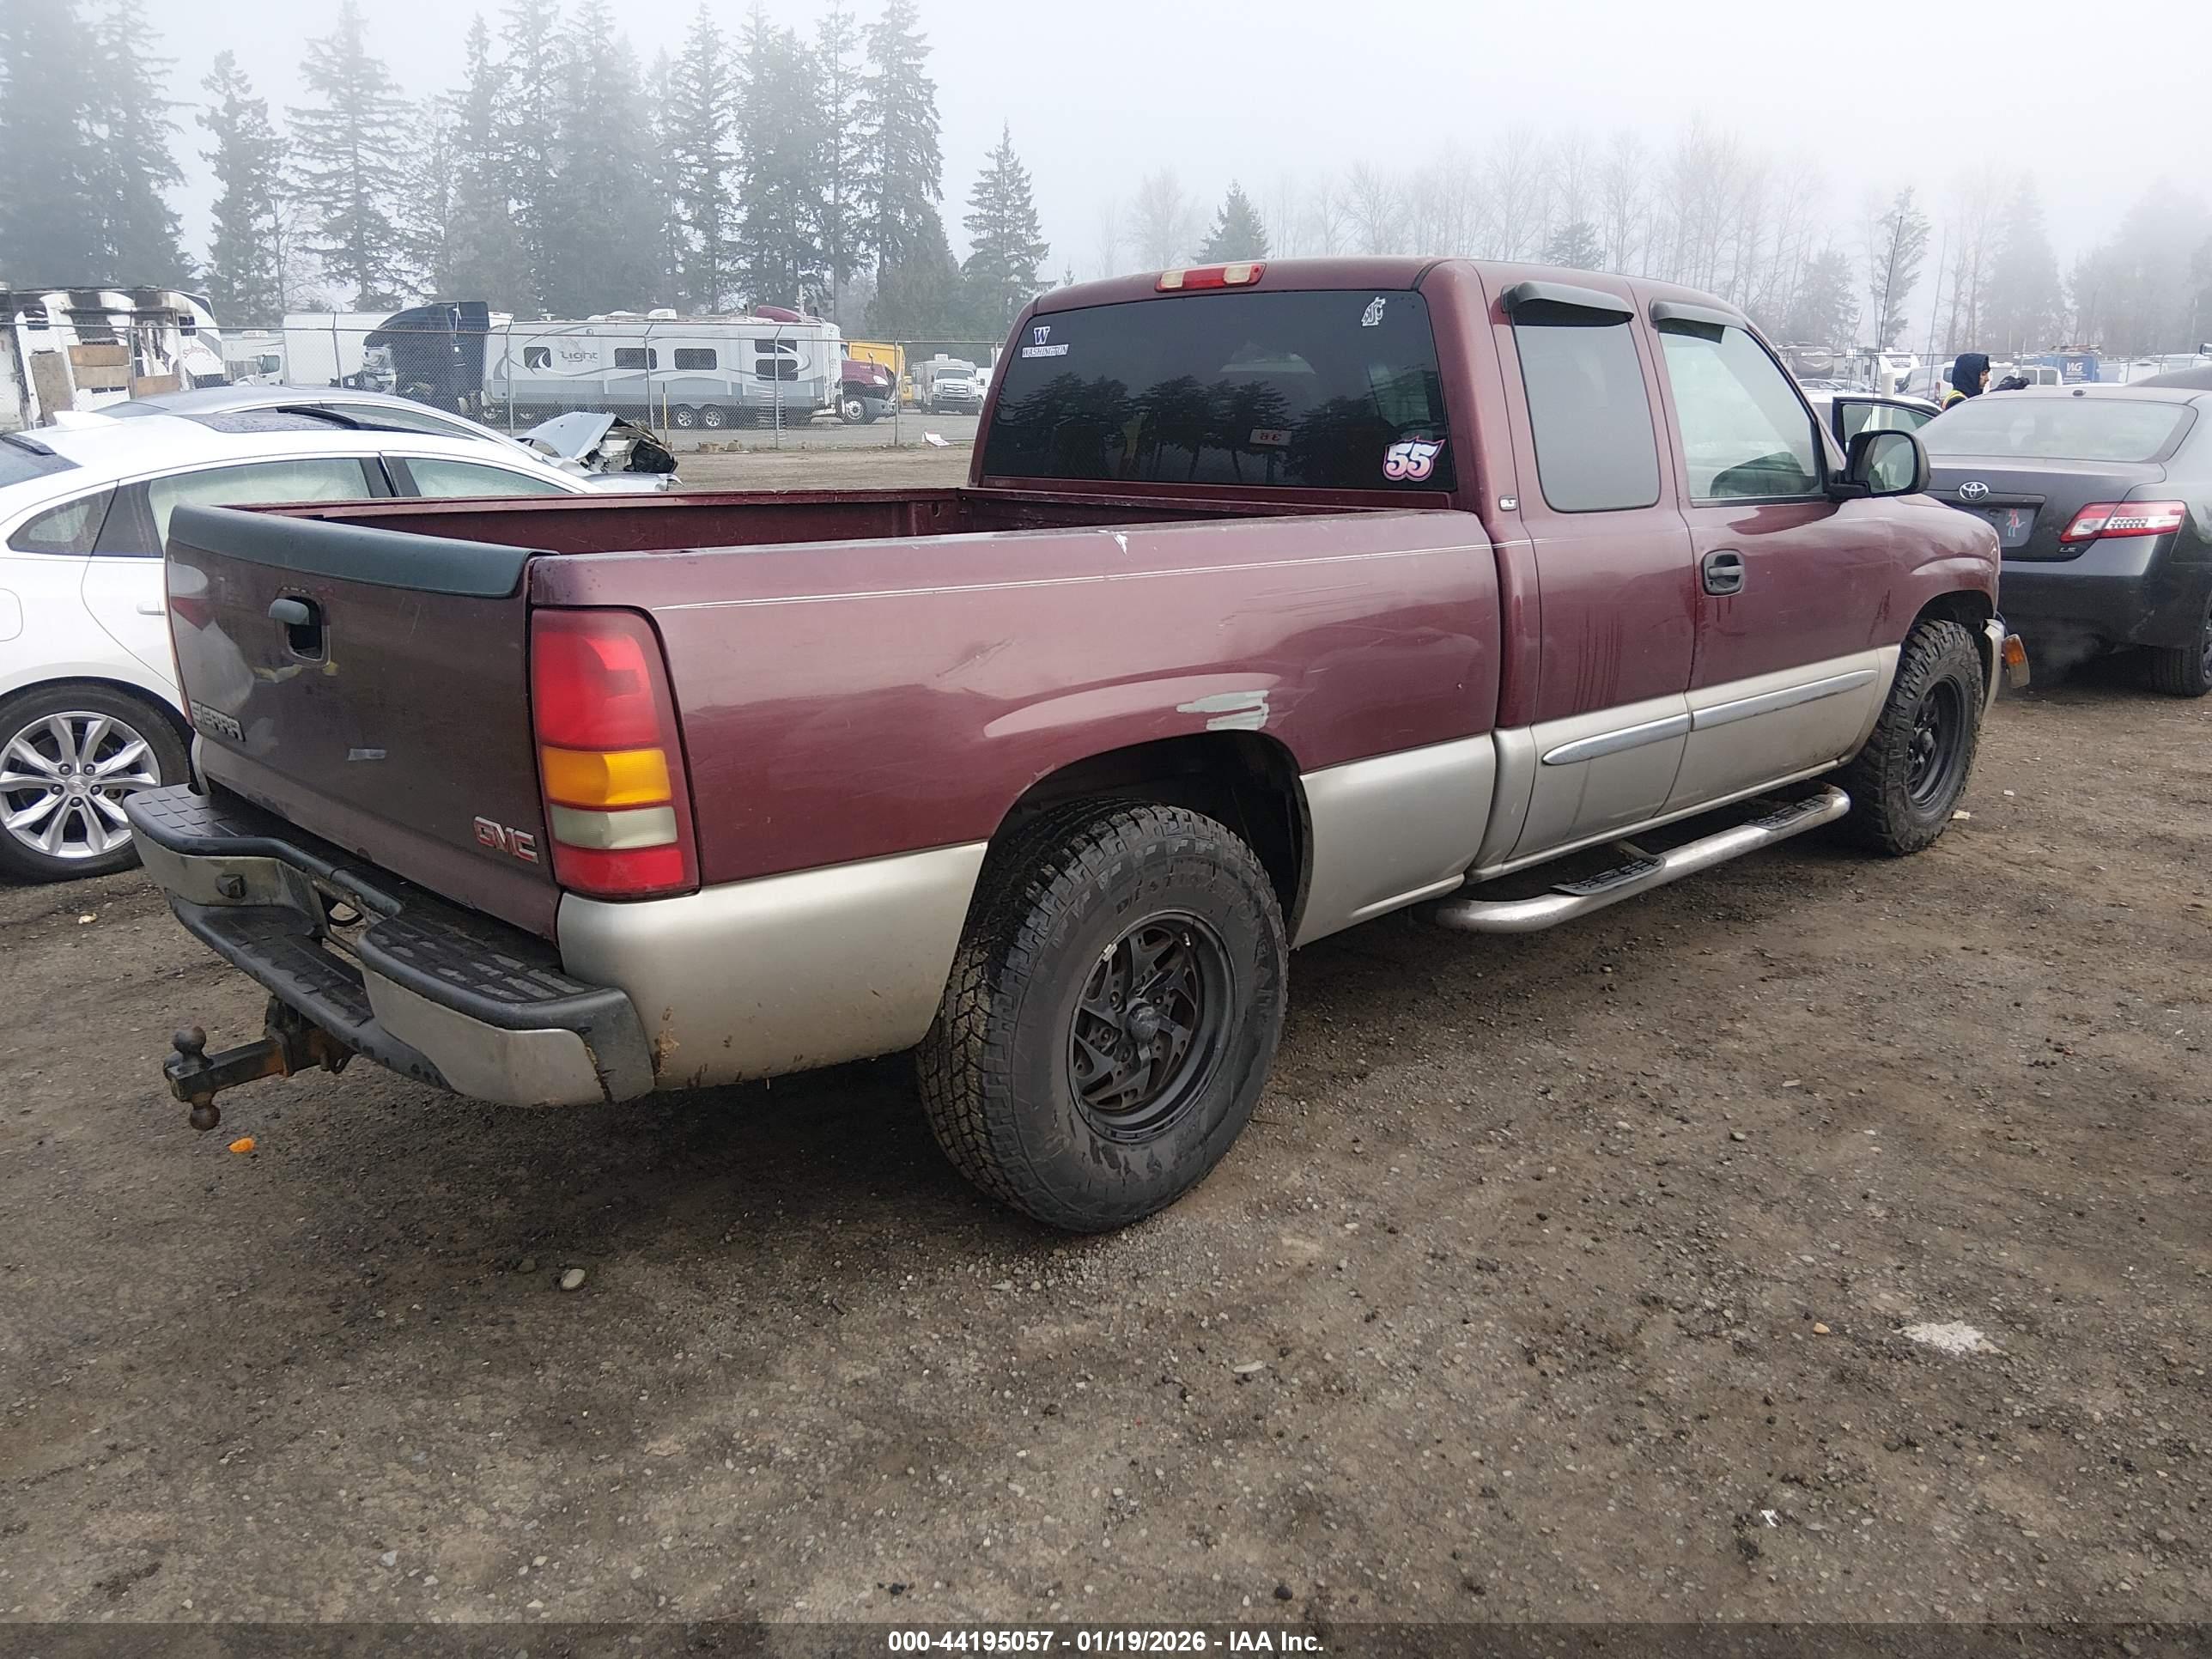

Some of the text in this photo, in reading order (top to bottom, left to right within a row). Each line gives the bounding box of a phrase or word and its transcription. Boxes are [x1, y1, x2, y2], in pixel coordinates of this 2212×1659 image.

[1033, 325, 1051, 345] W
[1384, 441, 1442, 479] 55
[191, 701, 244, 740] SIERRA
[473, 816, 540, 864] GMC
